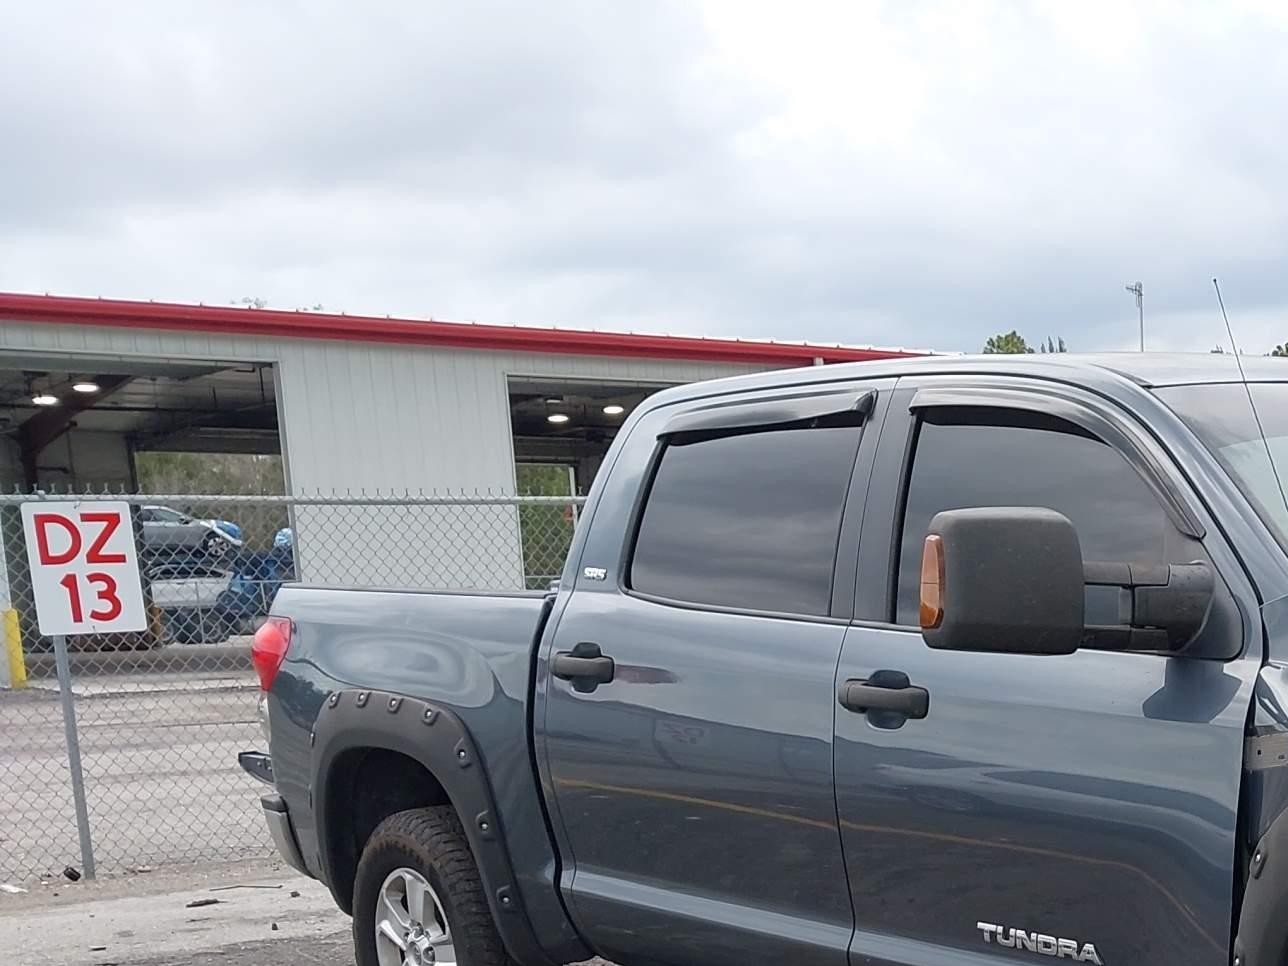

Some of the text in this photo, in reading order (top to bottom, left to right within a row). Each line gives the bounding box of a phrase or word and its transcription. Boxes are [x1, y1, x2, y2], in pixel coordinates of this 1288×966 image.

[33, 512, 127, 566] DZ
[59, 572, 122, 623] 13
[976, 921, 1104, 966] TUNDRA
